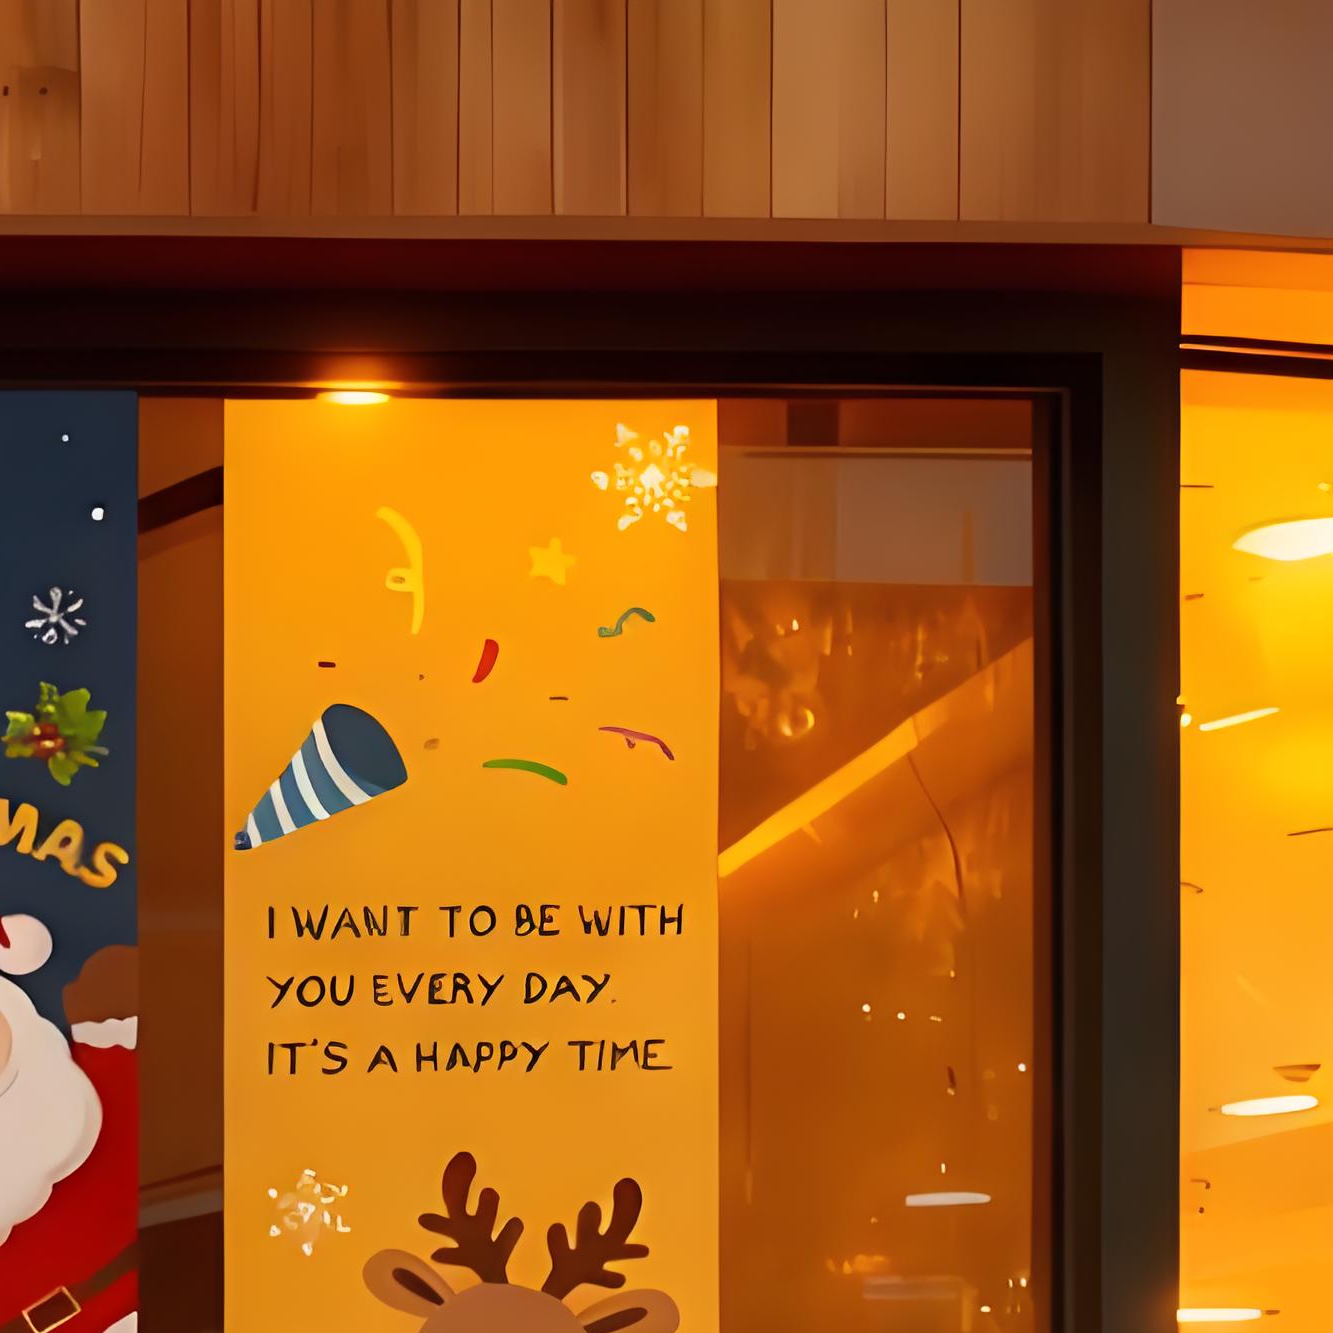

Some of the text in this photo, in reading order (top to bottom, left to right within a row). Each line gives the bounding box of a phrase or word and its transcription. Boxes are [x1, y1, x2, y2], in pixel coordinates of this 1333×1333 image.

[267, 903, 685, 940] I WANT TO BE WITH
[266, 972, 617, 1008] YOU EVERY DAY.
[267, 1038, 674, 1075] IT'S A HAPPY TIME
